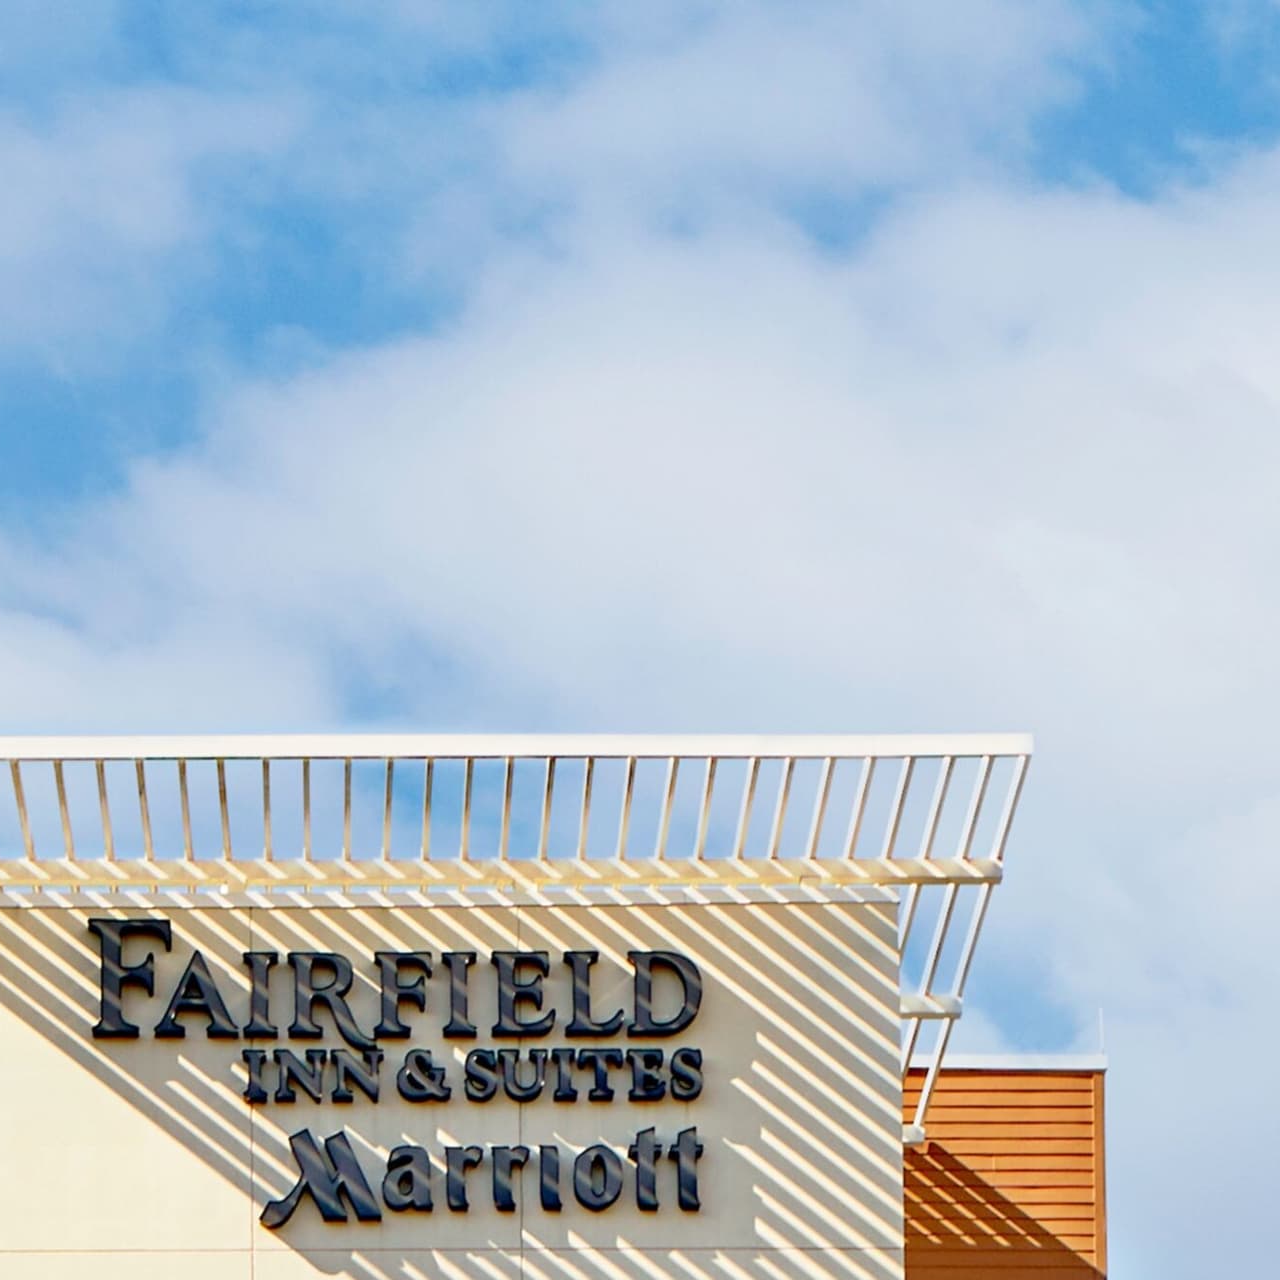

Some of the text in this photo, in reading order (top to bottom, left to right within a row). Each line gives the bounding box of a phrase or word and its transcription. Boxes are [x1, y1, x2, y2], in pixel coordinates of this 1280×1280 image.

[88, 918, 703, 1051] FAIRFIELD
[242, 1048, 704, 1104] INN & SUITES
[260, 1126, 704, 1229] Marriott
